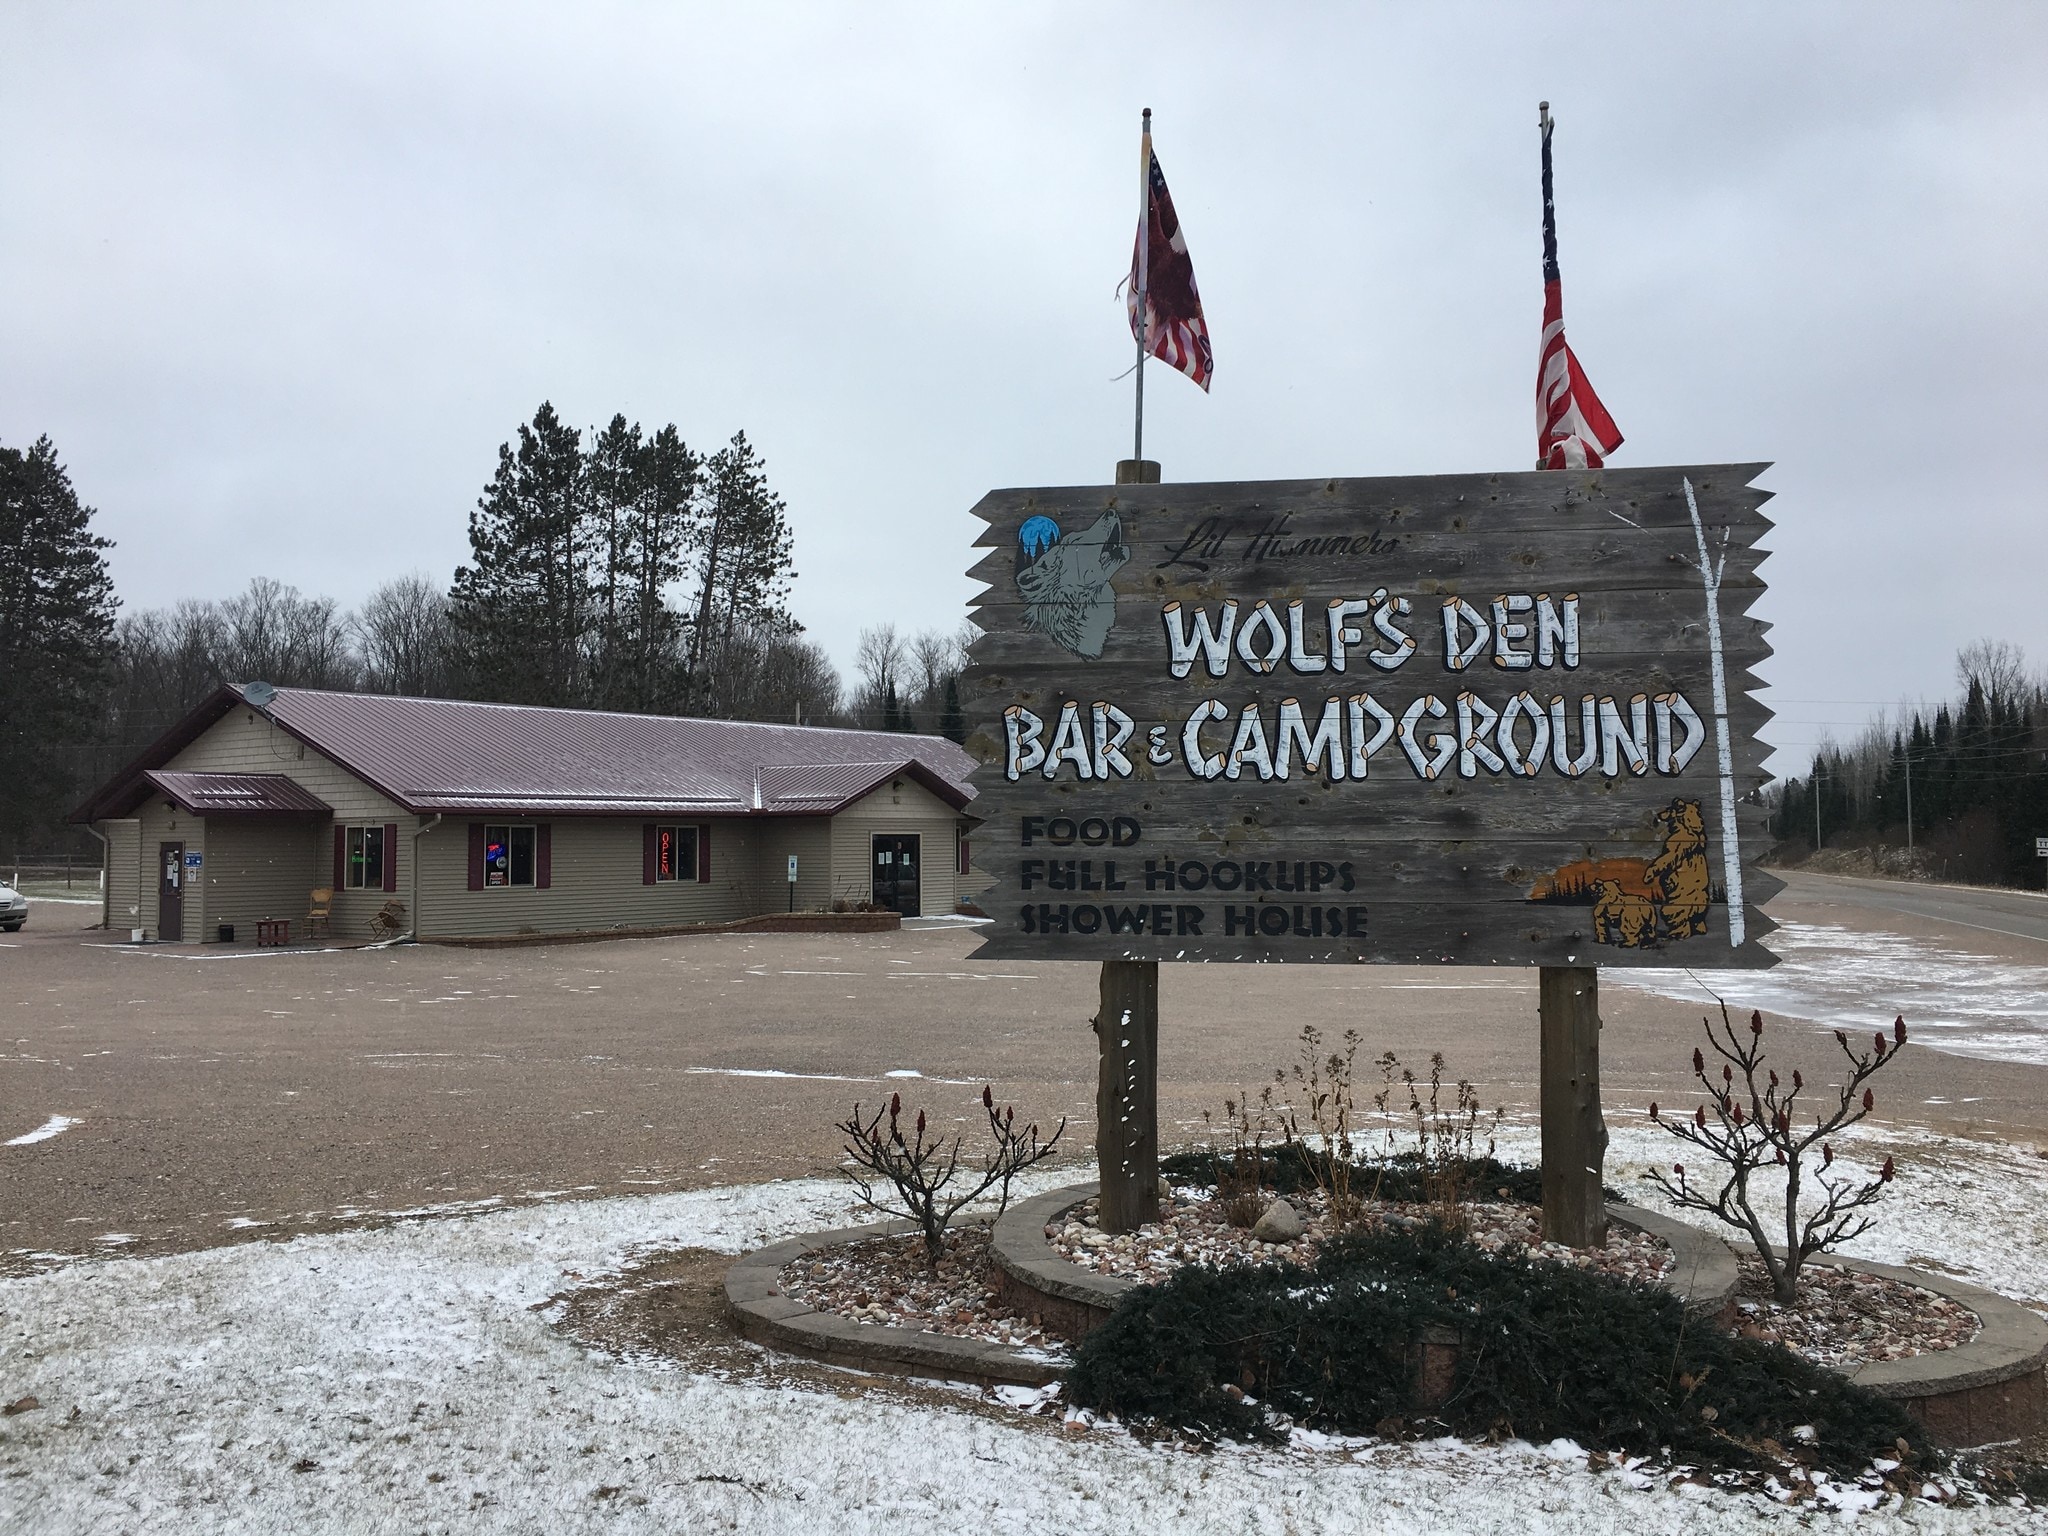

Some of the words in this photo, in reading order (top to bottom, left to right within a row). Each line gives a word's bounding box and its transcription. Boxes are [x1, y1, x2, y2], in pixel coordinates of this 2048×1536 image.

[1156, 517, 1233, 572] Lil
[1161, 587, 1417, 680] WOLF'S
[1440, 592, 1580, 672] DEN
[1003, 700, 1135, 781] BAR
[1148, 725, 1173, 766] &
[1181, 690, 1707, 782] CAMPGROUND
[1021, 816, 1142, 848] FOOD
[1021, 860, 1127, 891] FULL
[1145, 859, 1356, 892] HOOKUPS
[1020, 903, 1205, 936] SHOWER
[1224, 905, 1368, 938] HOUSE
